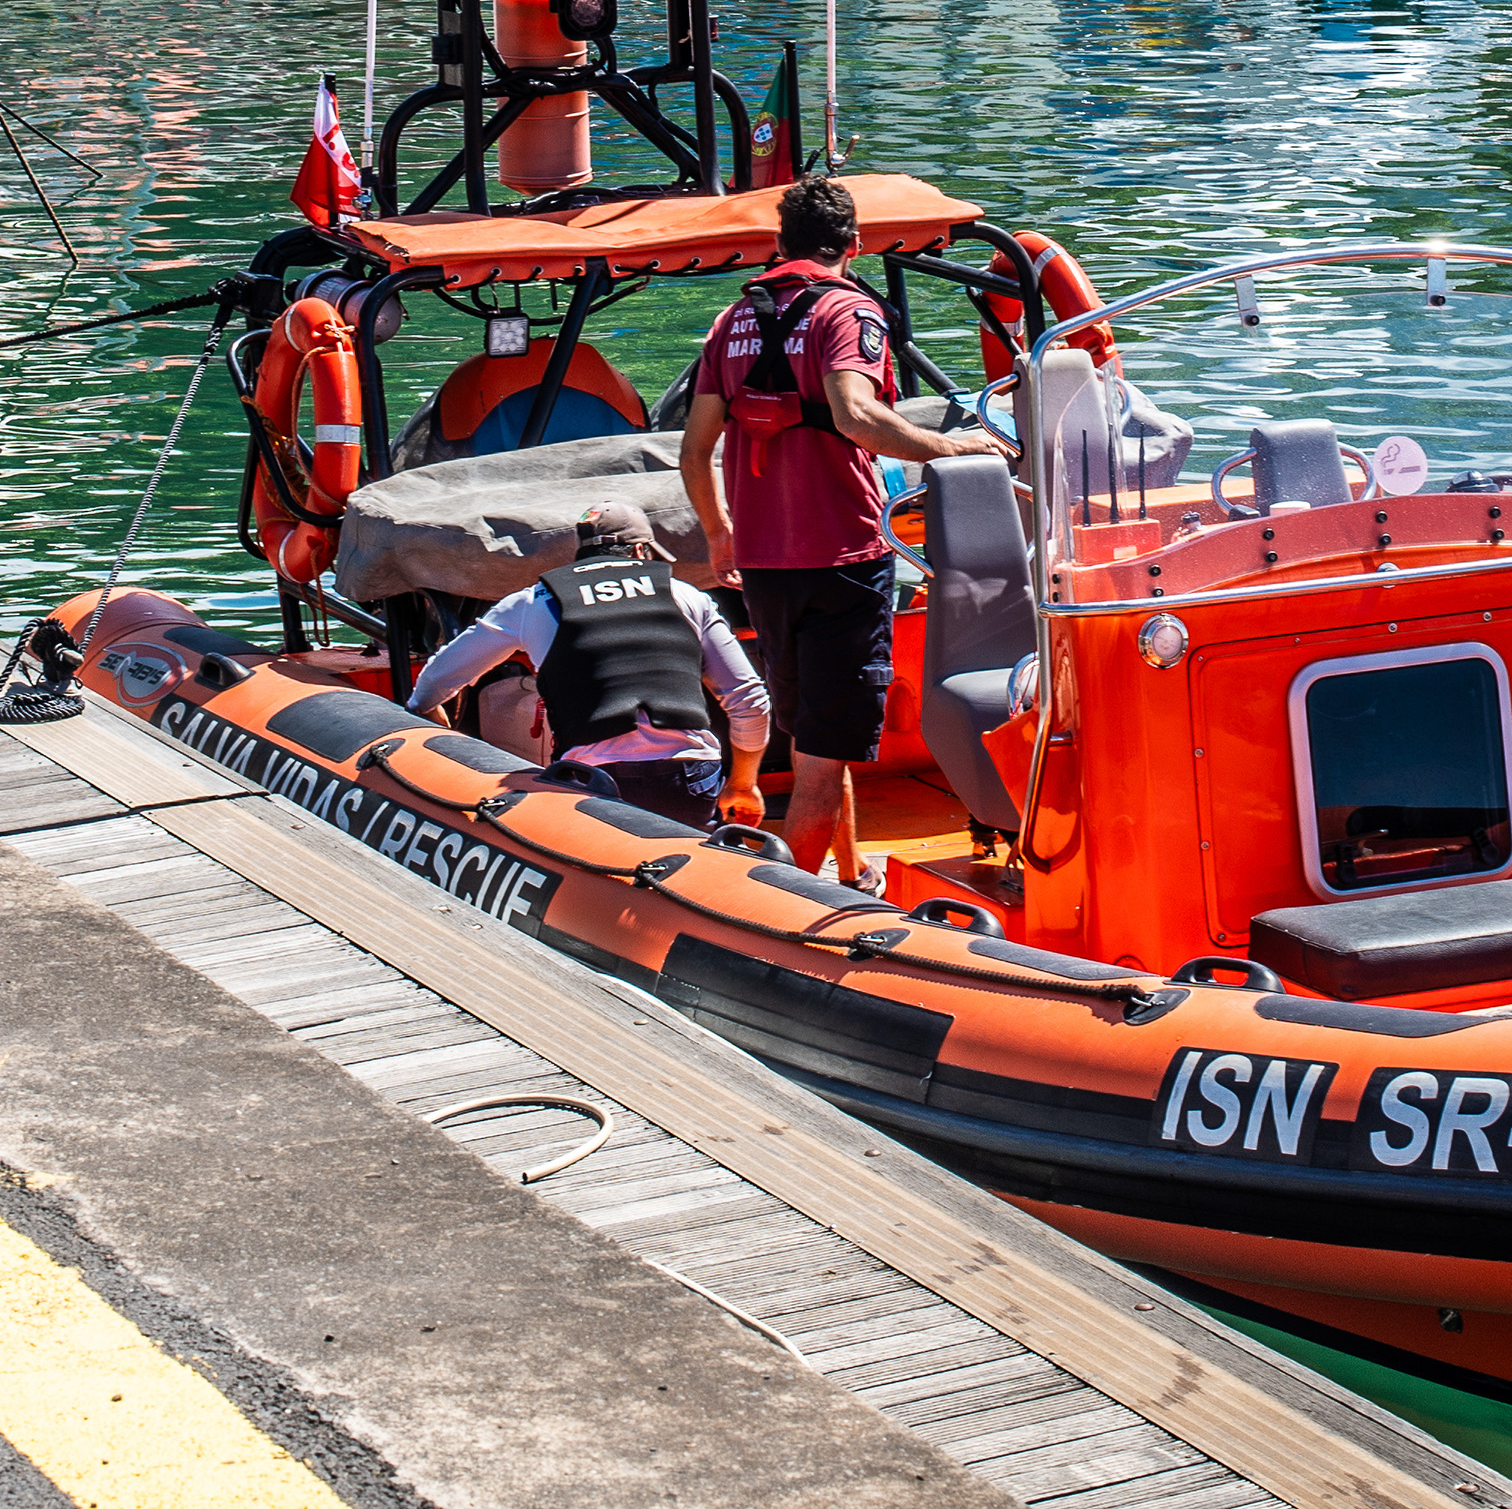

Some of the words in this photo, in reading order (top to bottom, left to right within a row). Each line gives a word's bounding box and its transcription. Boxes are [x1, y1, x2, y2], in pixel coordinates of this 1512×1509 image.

[578, 575, 657, 606] ISN
[160, 701, 258, 776] SALVA
[261, 748, 365, 834] VIDAS
[378, 808, 548, 924] RESCUE
[1161, 1050, 1326, 1156] ISN
